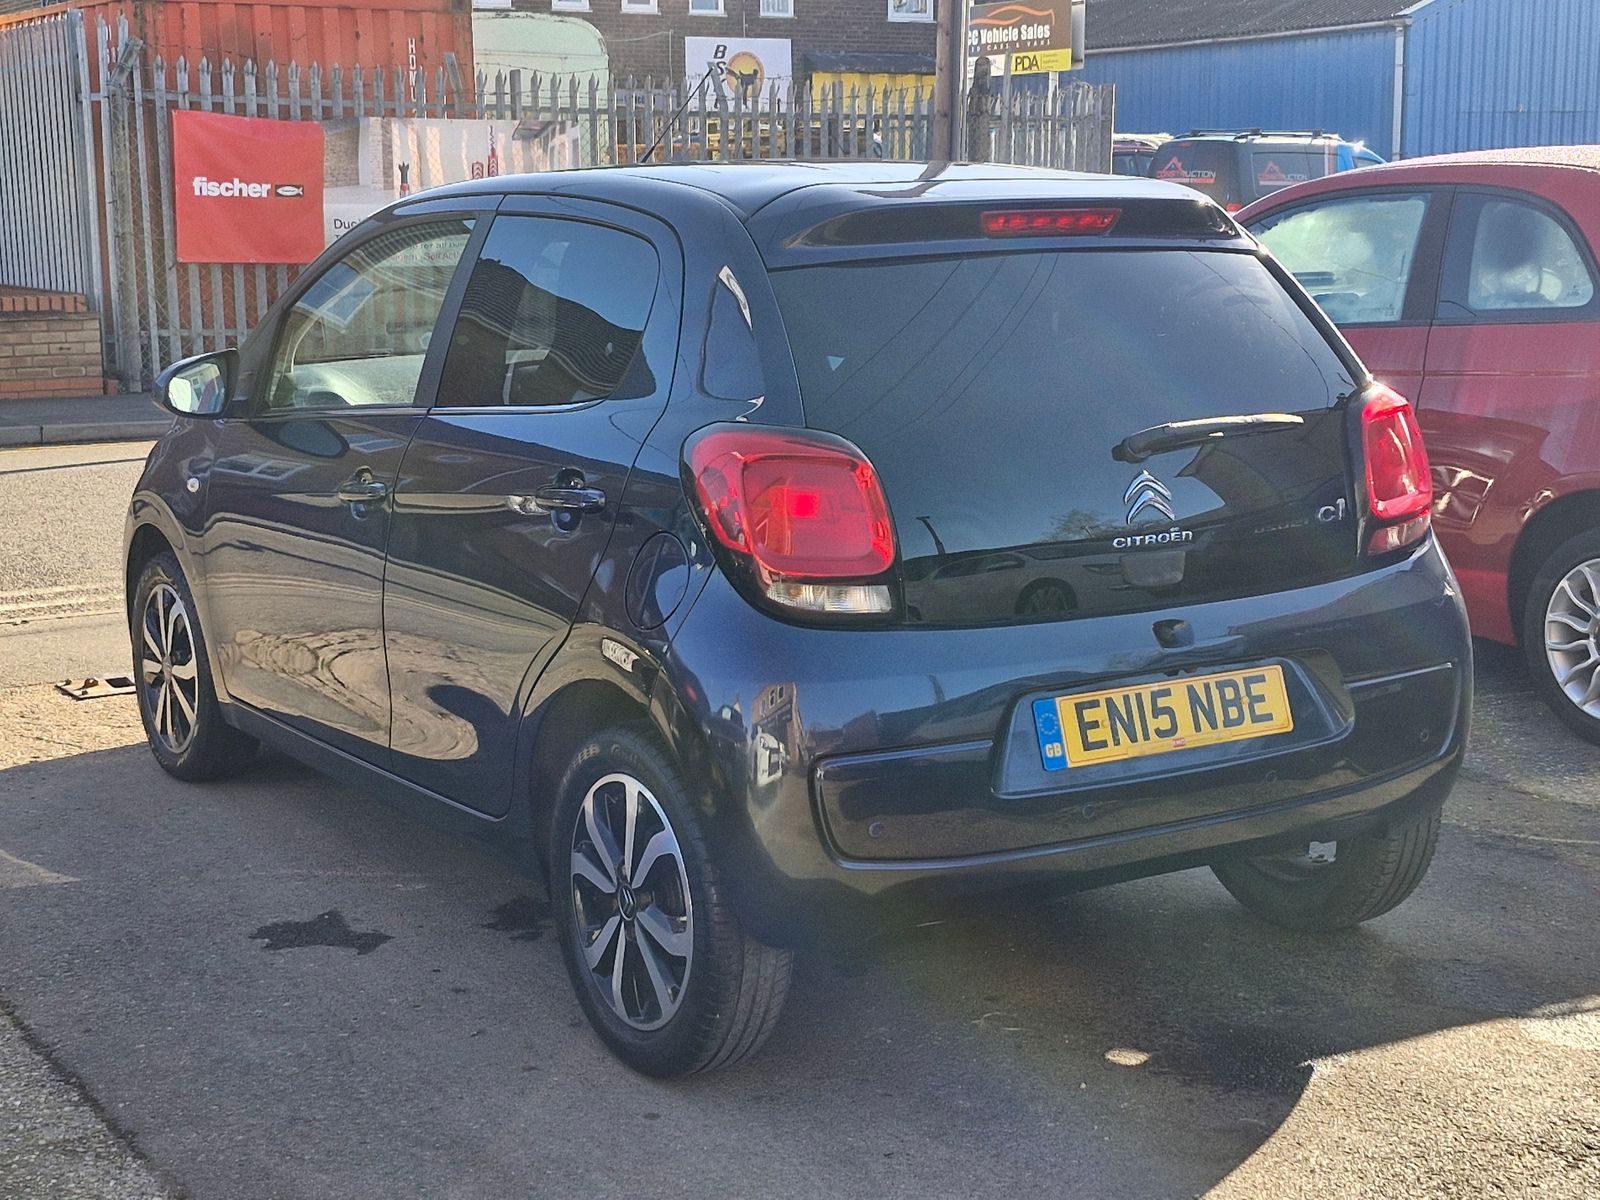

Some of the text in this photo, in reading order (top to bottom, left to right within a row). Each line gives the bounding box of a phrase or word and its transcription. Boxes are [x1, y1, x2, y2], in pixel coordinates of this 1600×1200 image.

[980, 25, 1019, 44] Vehicle
[1020, 23, 1051, 40] Sales
[1014, 54, 1040, 72] PDA
[192, 176, 272, 198] fischer
[1074, 674, 1274, 752] EN15 NBE
[1045, 743, 1062, 758] GB
